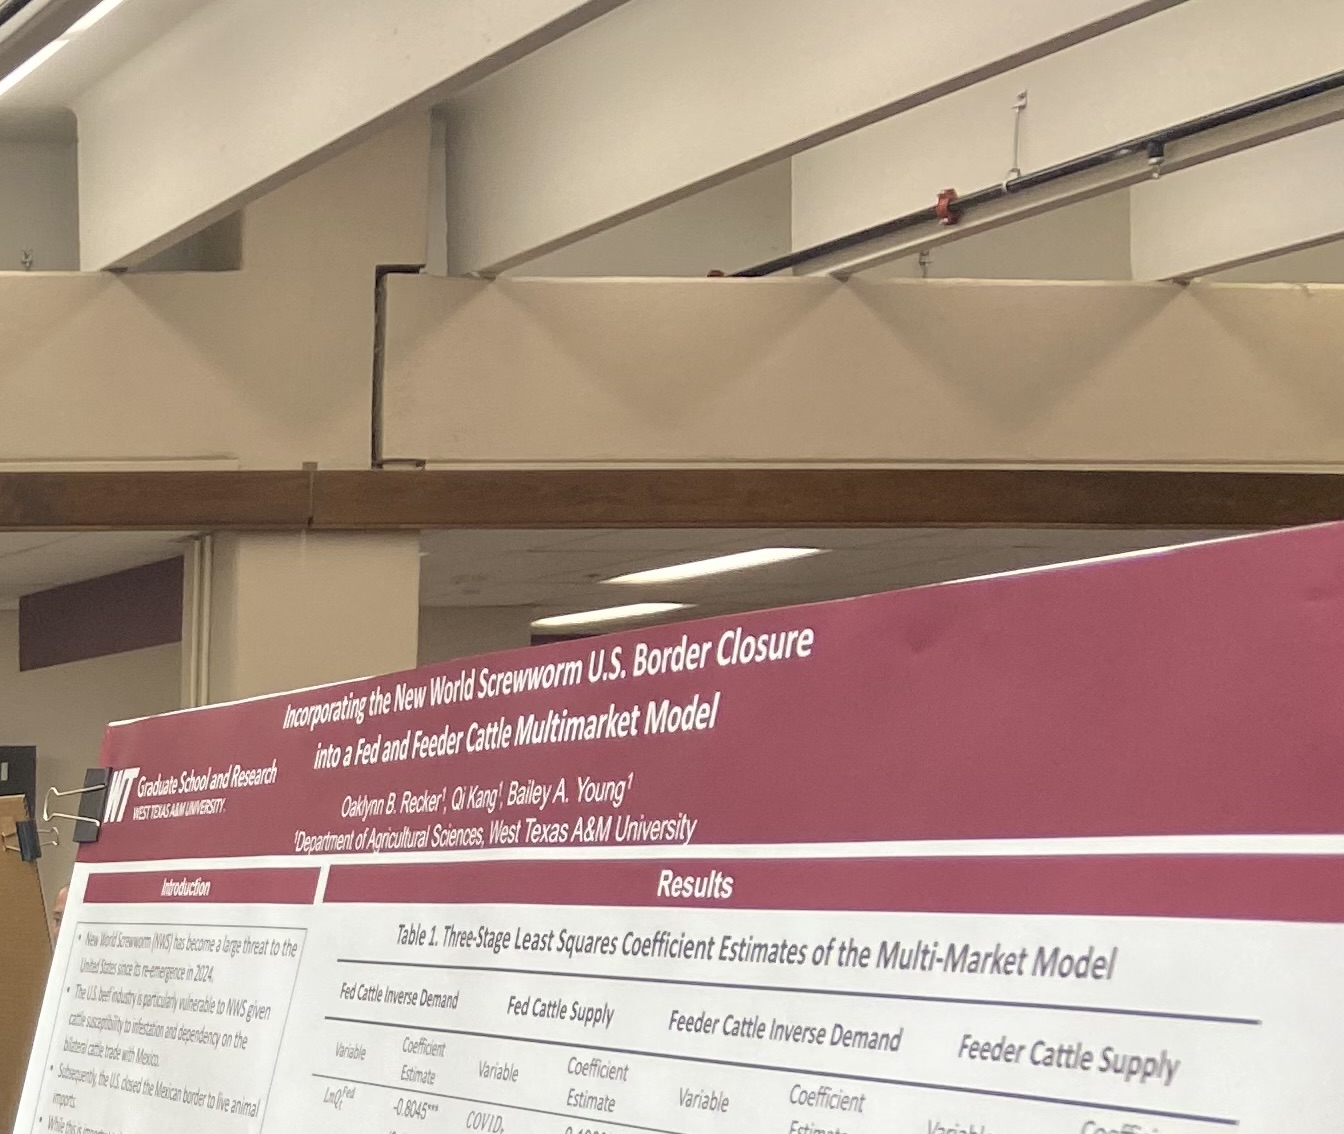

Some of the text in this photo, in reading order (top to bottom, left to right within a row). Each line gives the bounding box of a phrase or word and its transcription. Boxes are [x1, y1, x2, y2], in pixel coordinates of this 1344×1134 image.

[283, 627, 814, 731] Incorporating the New World Screwworm U.S. Border Closure
[313, 691, 721, 770] into a Fed and Feeder Cattle Multimarket Model
[137, 758, 278, 798] Graduate School and Research
[132, 803, 151, 821] WEST
[150, 802, 171, 820] TEXAS
[169, 800, 186, 818] A&M
[341, 795, 385, 822] Oaklynn
[385, 792, 397, 815] B.
[451, 785, 467, 811] Qi
[506, 779, 552, 810] Bailey
[551, 777, 569, 804] A.
[354, 827, 370, 850] of
[368, 825, 431, 854] Agricultural
[431, 823, 485, 849] Sciences,
[489, 819, 522, 844] West
[524, 817, 569, 844] Texas
[570, 815, 613, 843] A&M
[614, 811, 698, 846] University
[161, 877, 211, 897] Introduction
[657, 869, 734, 899] Results
[242, 937, 298, 958] threat to the
[396, 924, 1119, 981] Table 1. Three-Stage Least Squares Coefficient Estimates of the Multi-Market Model
[340, 982, 460, 1010] Fed Cattle Inverse Demand
[506, 995, 616, 1030] Fed Cattle Supply
[402, 1036, 446, 1058] Coefficient
[668, 1009, 904, 1054] Feeder Cattle Inverse Demand
[335, 1041, 437, 1086] Variable Estimate
[567, 1056, 630, 1082] Coefficient
[958, 1033, 1182, 1088] Feeder Cattle Supply
[478, 1059, 617, 1114] Variable Estimate
[678, 1086, 730, 1114] Variable
[789, 1083, 867, 1115] Coefficient
